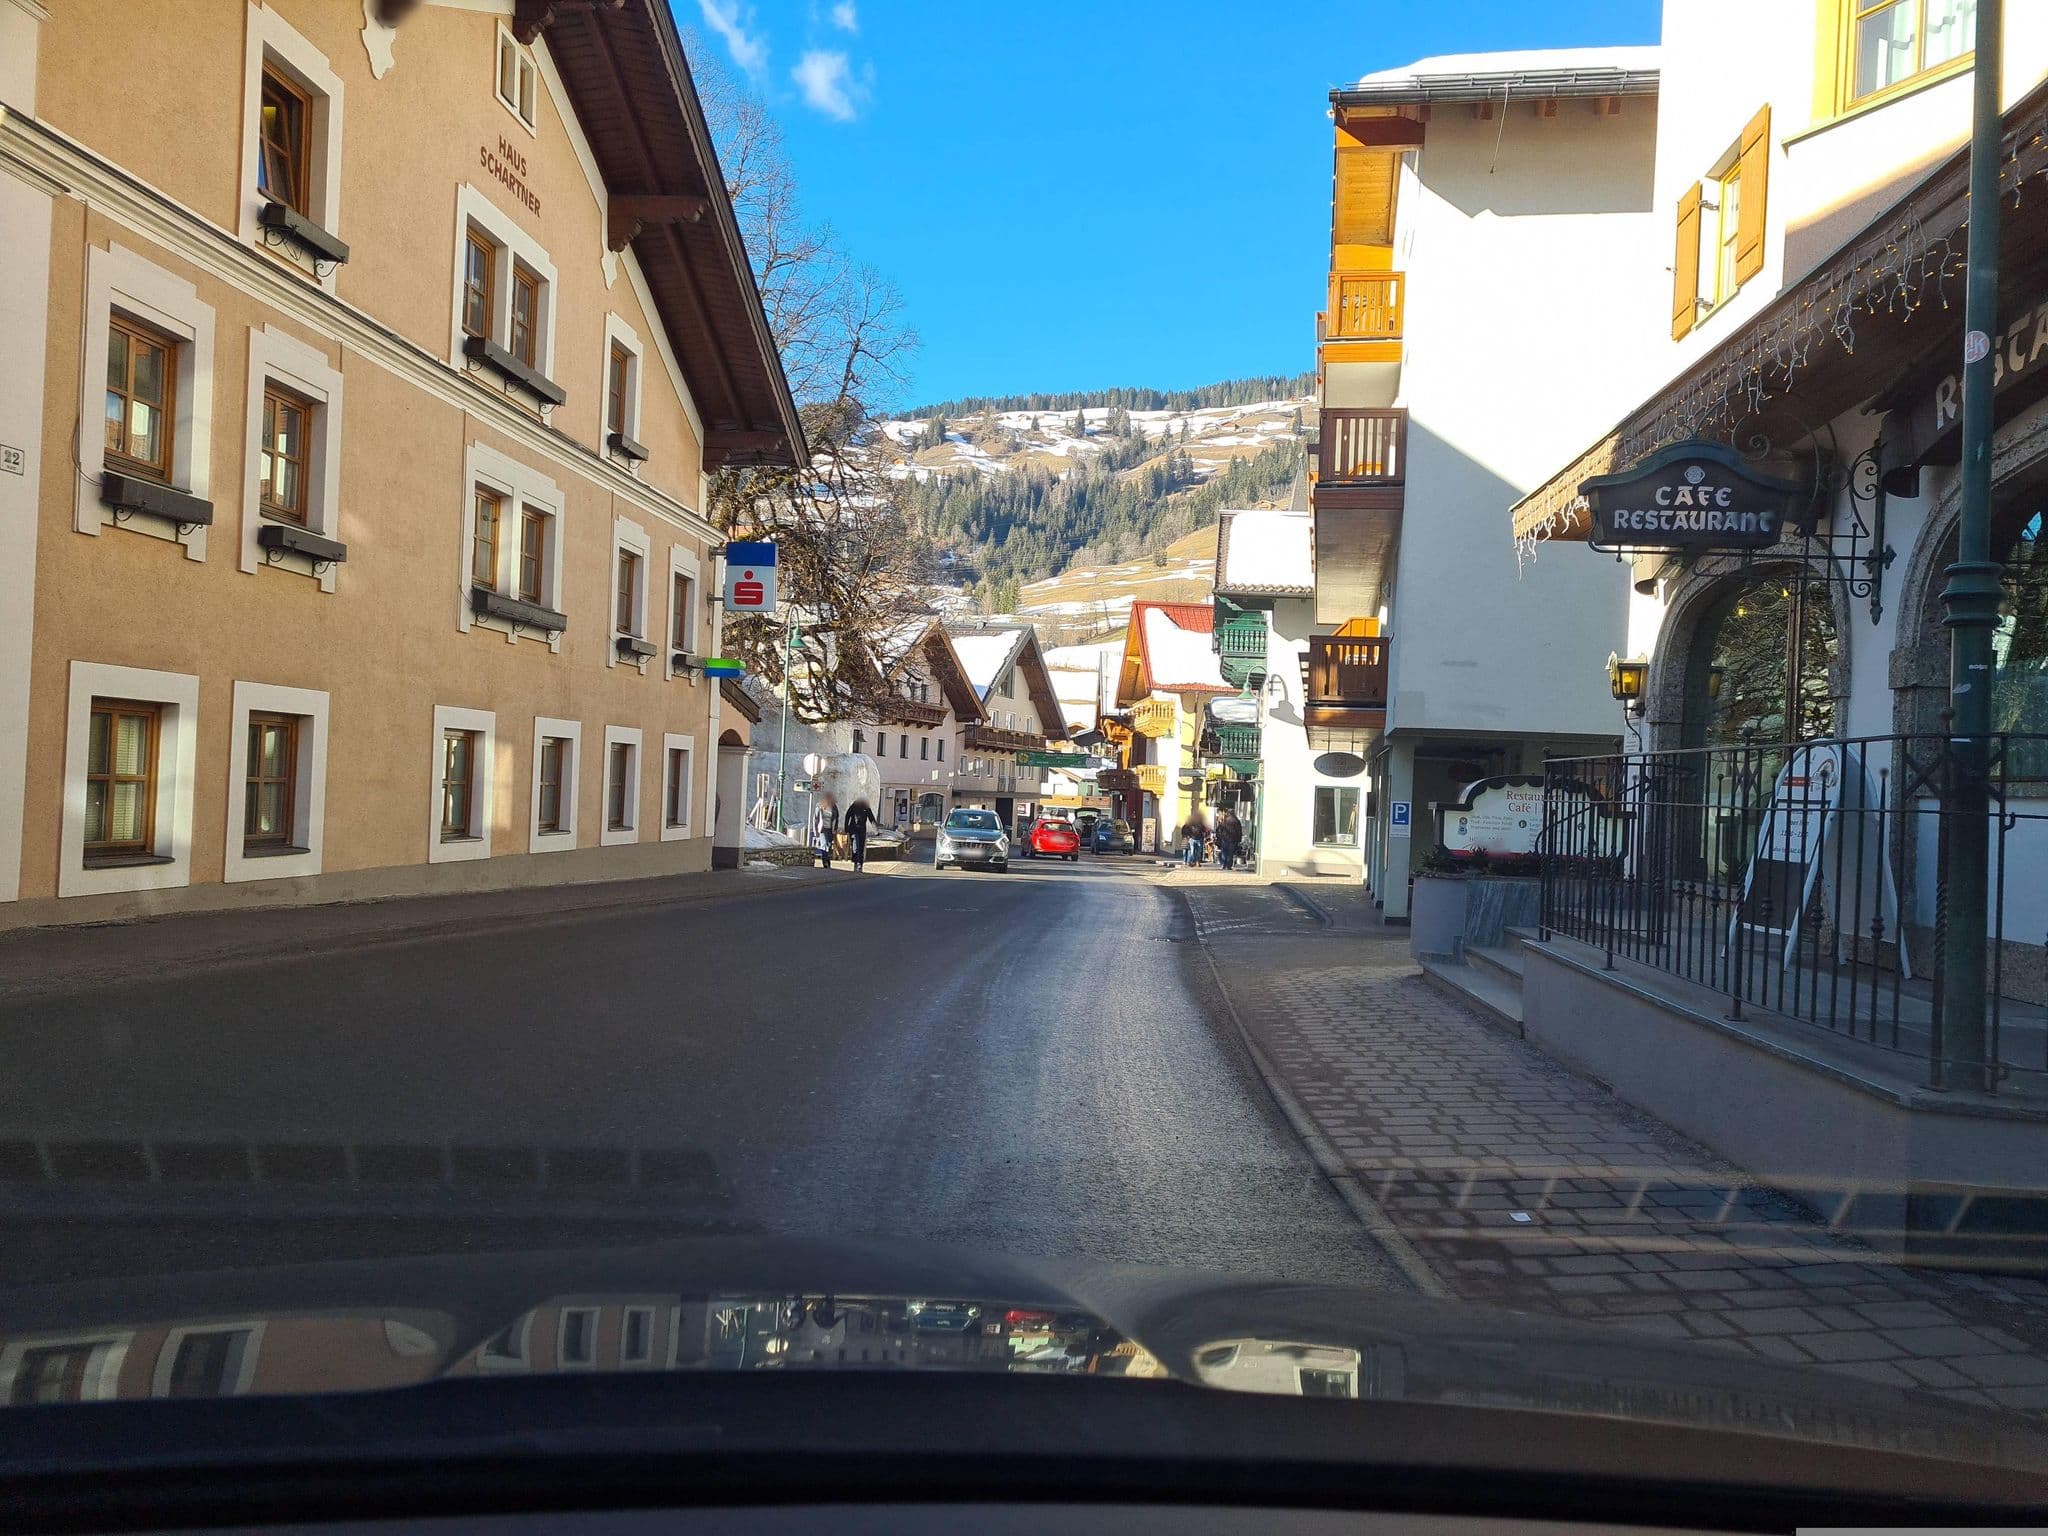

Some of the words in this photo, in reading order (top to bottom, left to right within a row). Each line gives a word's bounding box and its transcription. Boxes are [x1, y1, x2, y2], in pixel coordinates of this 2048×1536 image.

[499, 135, 527, 177] HAUS
[480, 146, 541, 218] SCHARTNER
[1655, 486, 1732, 507] CAFE
[1613, 509, 1777, 532] RESTAURANT
[1395, 804, 1407, 819] P
[1508, 802, 1531, 813] Café
